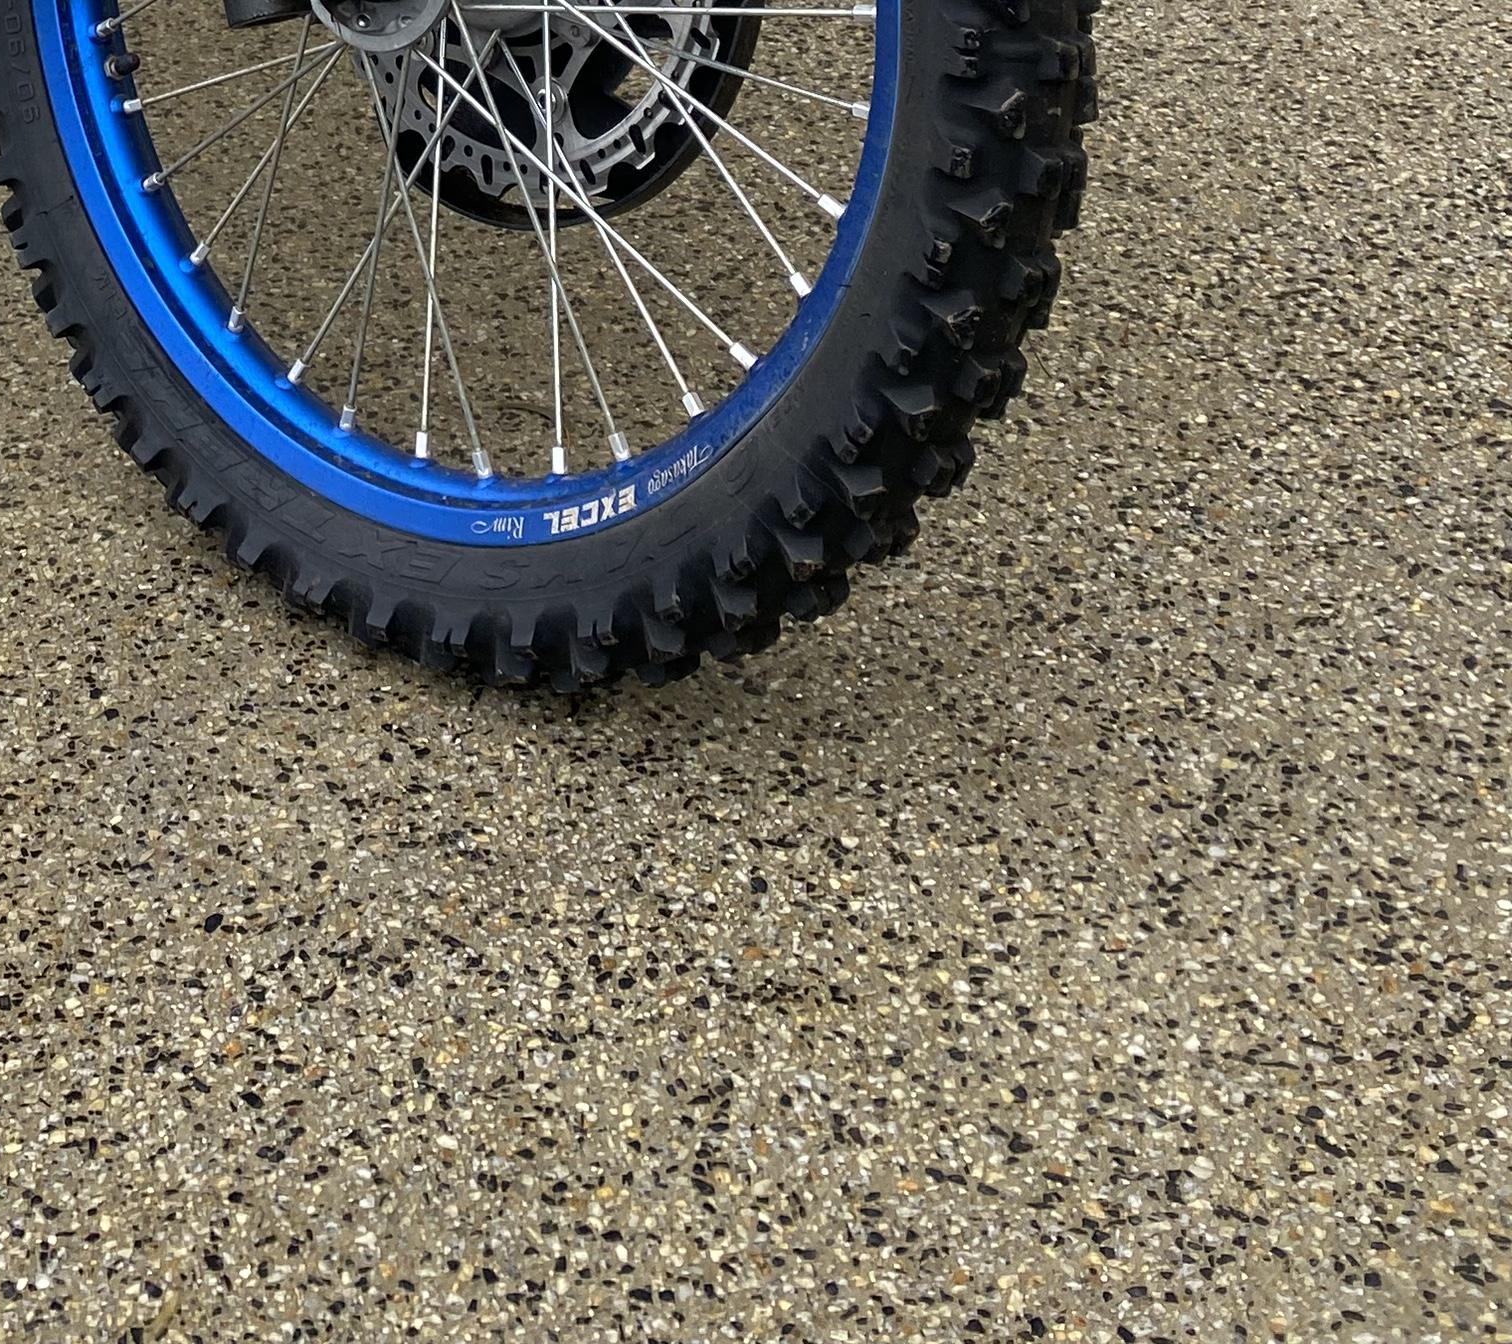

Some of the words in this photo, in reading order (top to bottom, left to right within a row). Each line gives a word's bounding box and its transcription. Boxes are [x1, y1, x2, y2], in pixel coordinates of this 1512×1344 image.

[646, 442, 715, 496] Takasago
[470, 516, 525, 541] Rim
[542, 483, 639, 536] EXCEL
